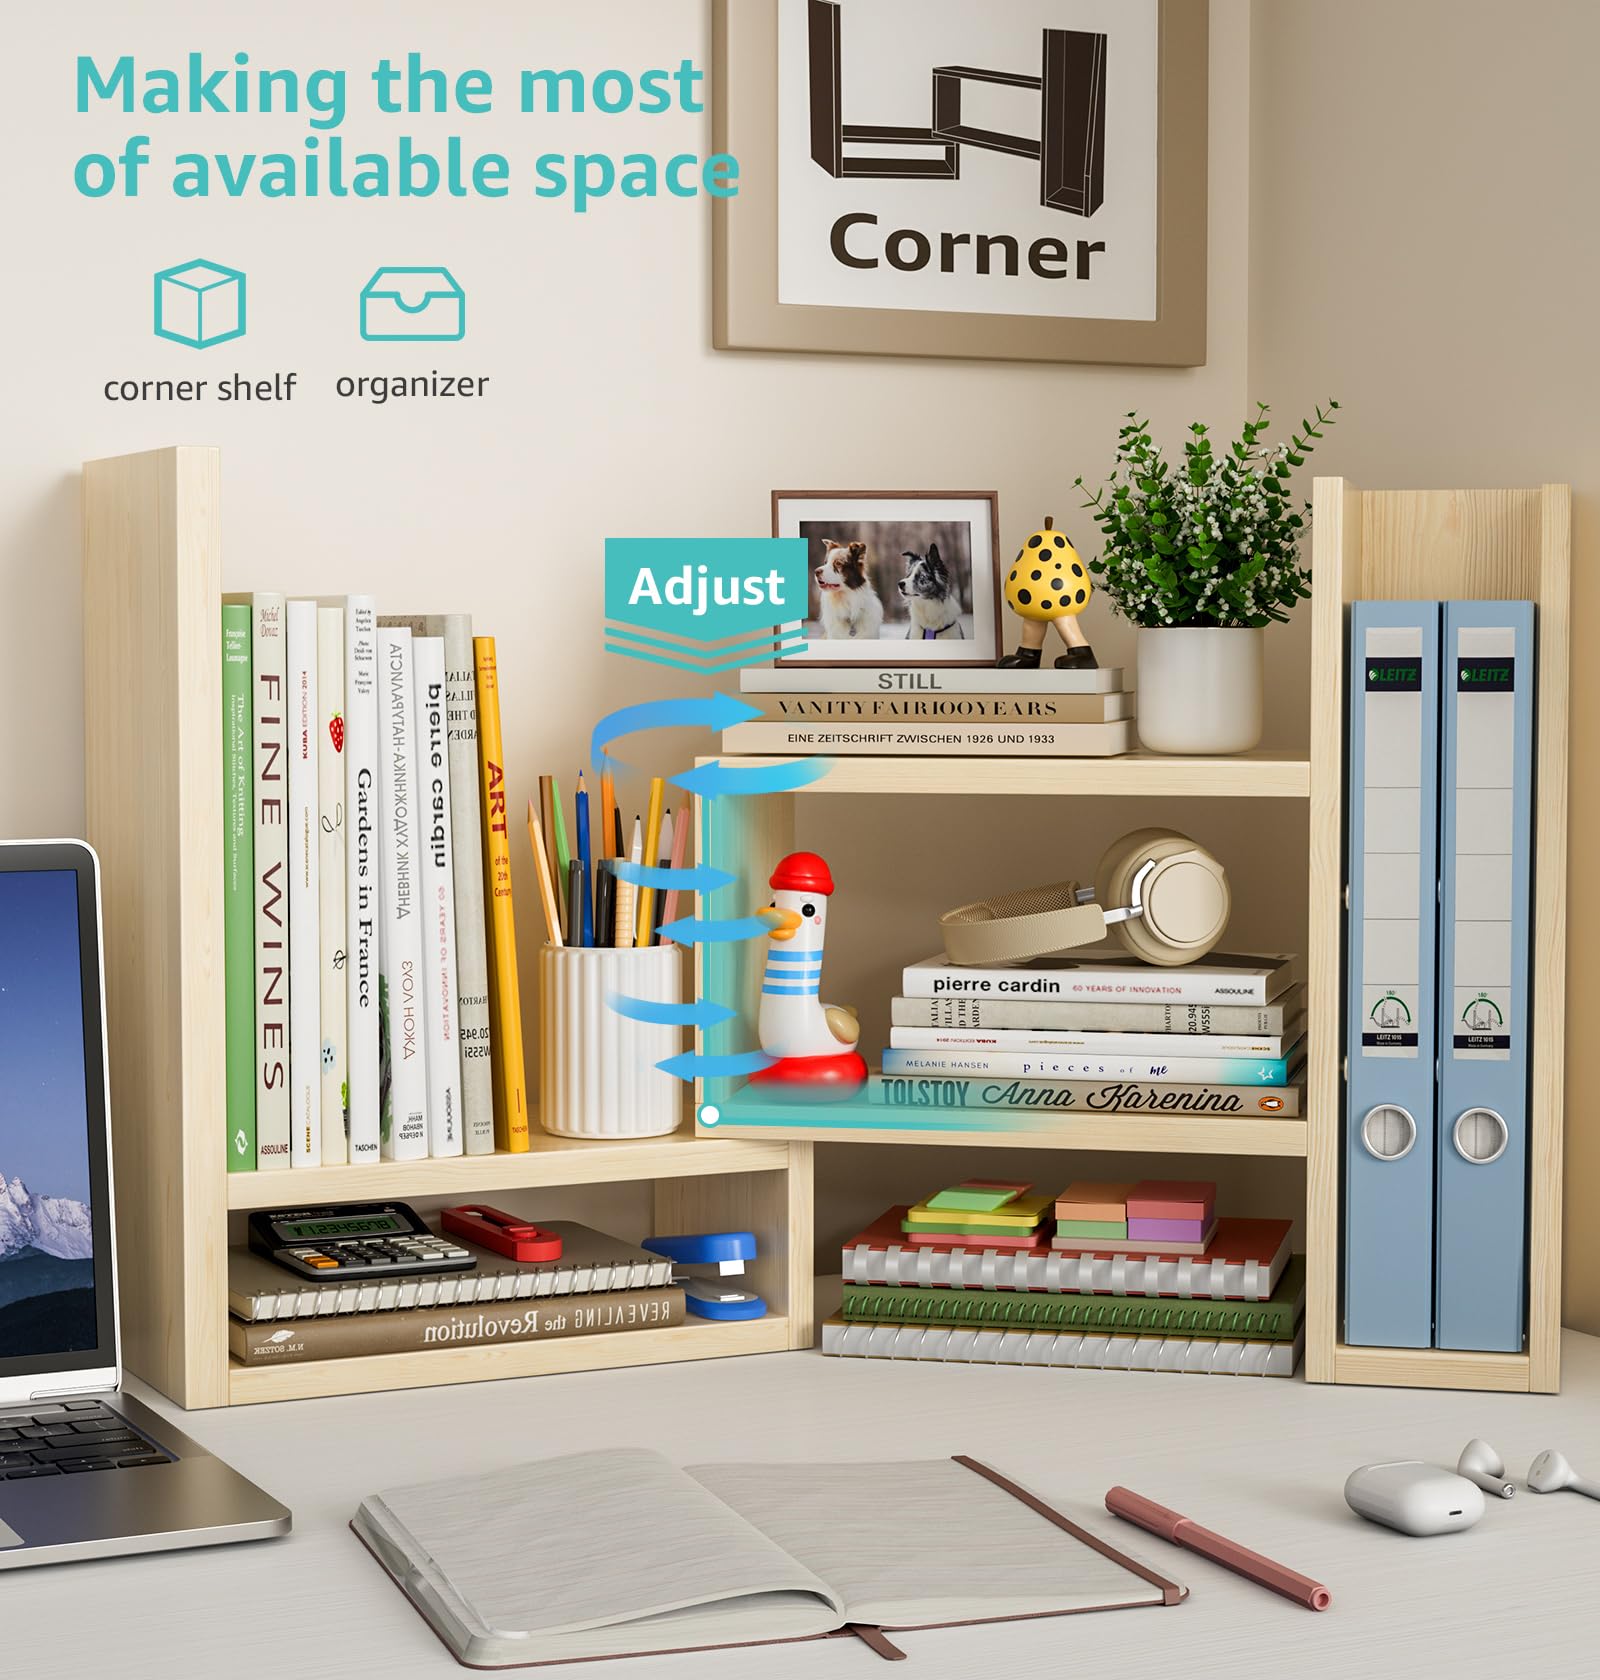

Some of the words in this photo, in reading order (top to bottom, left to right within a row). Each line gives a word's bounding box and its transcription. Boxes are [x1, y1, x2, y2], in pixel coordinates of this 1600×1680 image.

[829, 212, 1106, 281] Corner
[878, 673, 942, 690] STILL
[1379, 668, 1417, 682] LEITZ
[1472, 668, 1510, 682] LEITZ
[778, 700, 866, 715] VANITY
[787, 733, 814, 743] EINE
[818, 733, 893, 743] ZEITSCHRIFT
[897, 734, 962, 744] ZWISCHEN
[967, 734, 994, 744] 1926
[998, 735, 1025, 744] UND
[1028, 735, 1055, 744] 1933
[260, 674, 282, 825] FINE
[238, 756, 246, 771] of
[237, 775, 246, 836] Knitting
[488, 761, 507, 839] ART
[357, 768, 372, 877] Gardens
[358, 886, 373, 909] in
[358, 917, 373, 1008] France
[262, 861, 284, 1090] WINES
[933, 976, 992, 993] pierre
[998, 978, 1060, 993] cardin
[1072, 984, 1083, 992] 60
[1086, 985, 1113, 993] YEARS
[1129, 986, 1182, 994] INNOVATION
[905, 1060, 947, 1068] MELANIE
[951, 1061, 989, 1069] HANSEN
[1023, 1061, 1105, 1074] pieces
[881, 1078, 970, 1107] TOLSTOY
[981, 1081, 1076, 1108] Anna
[1086, 1083, 1244, 1113] Karenina
[261, 1143, 288, 1155] ASSOULINE
[355, 1143, 378, 1152] TASCHEN
